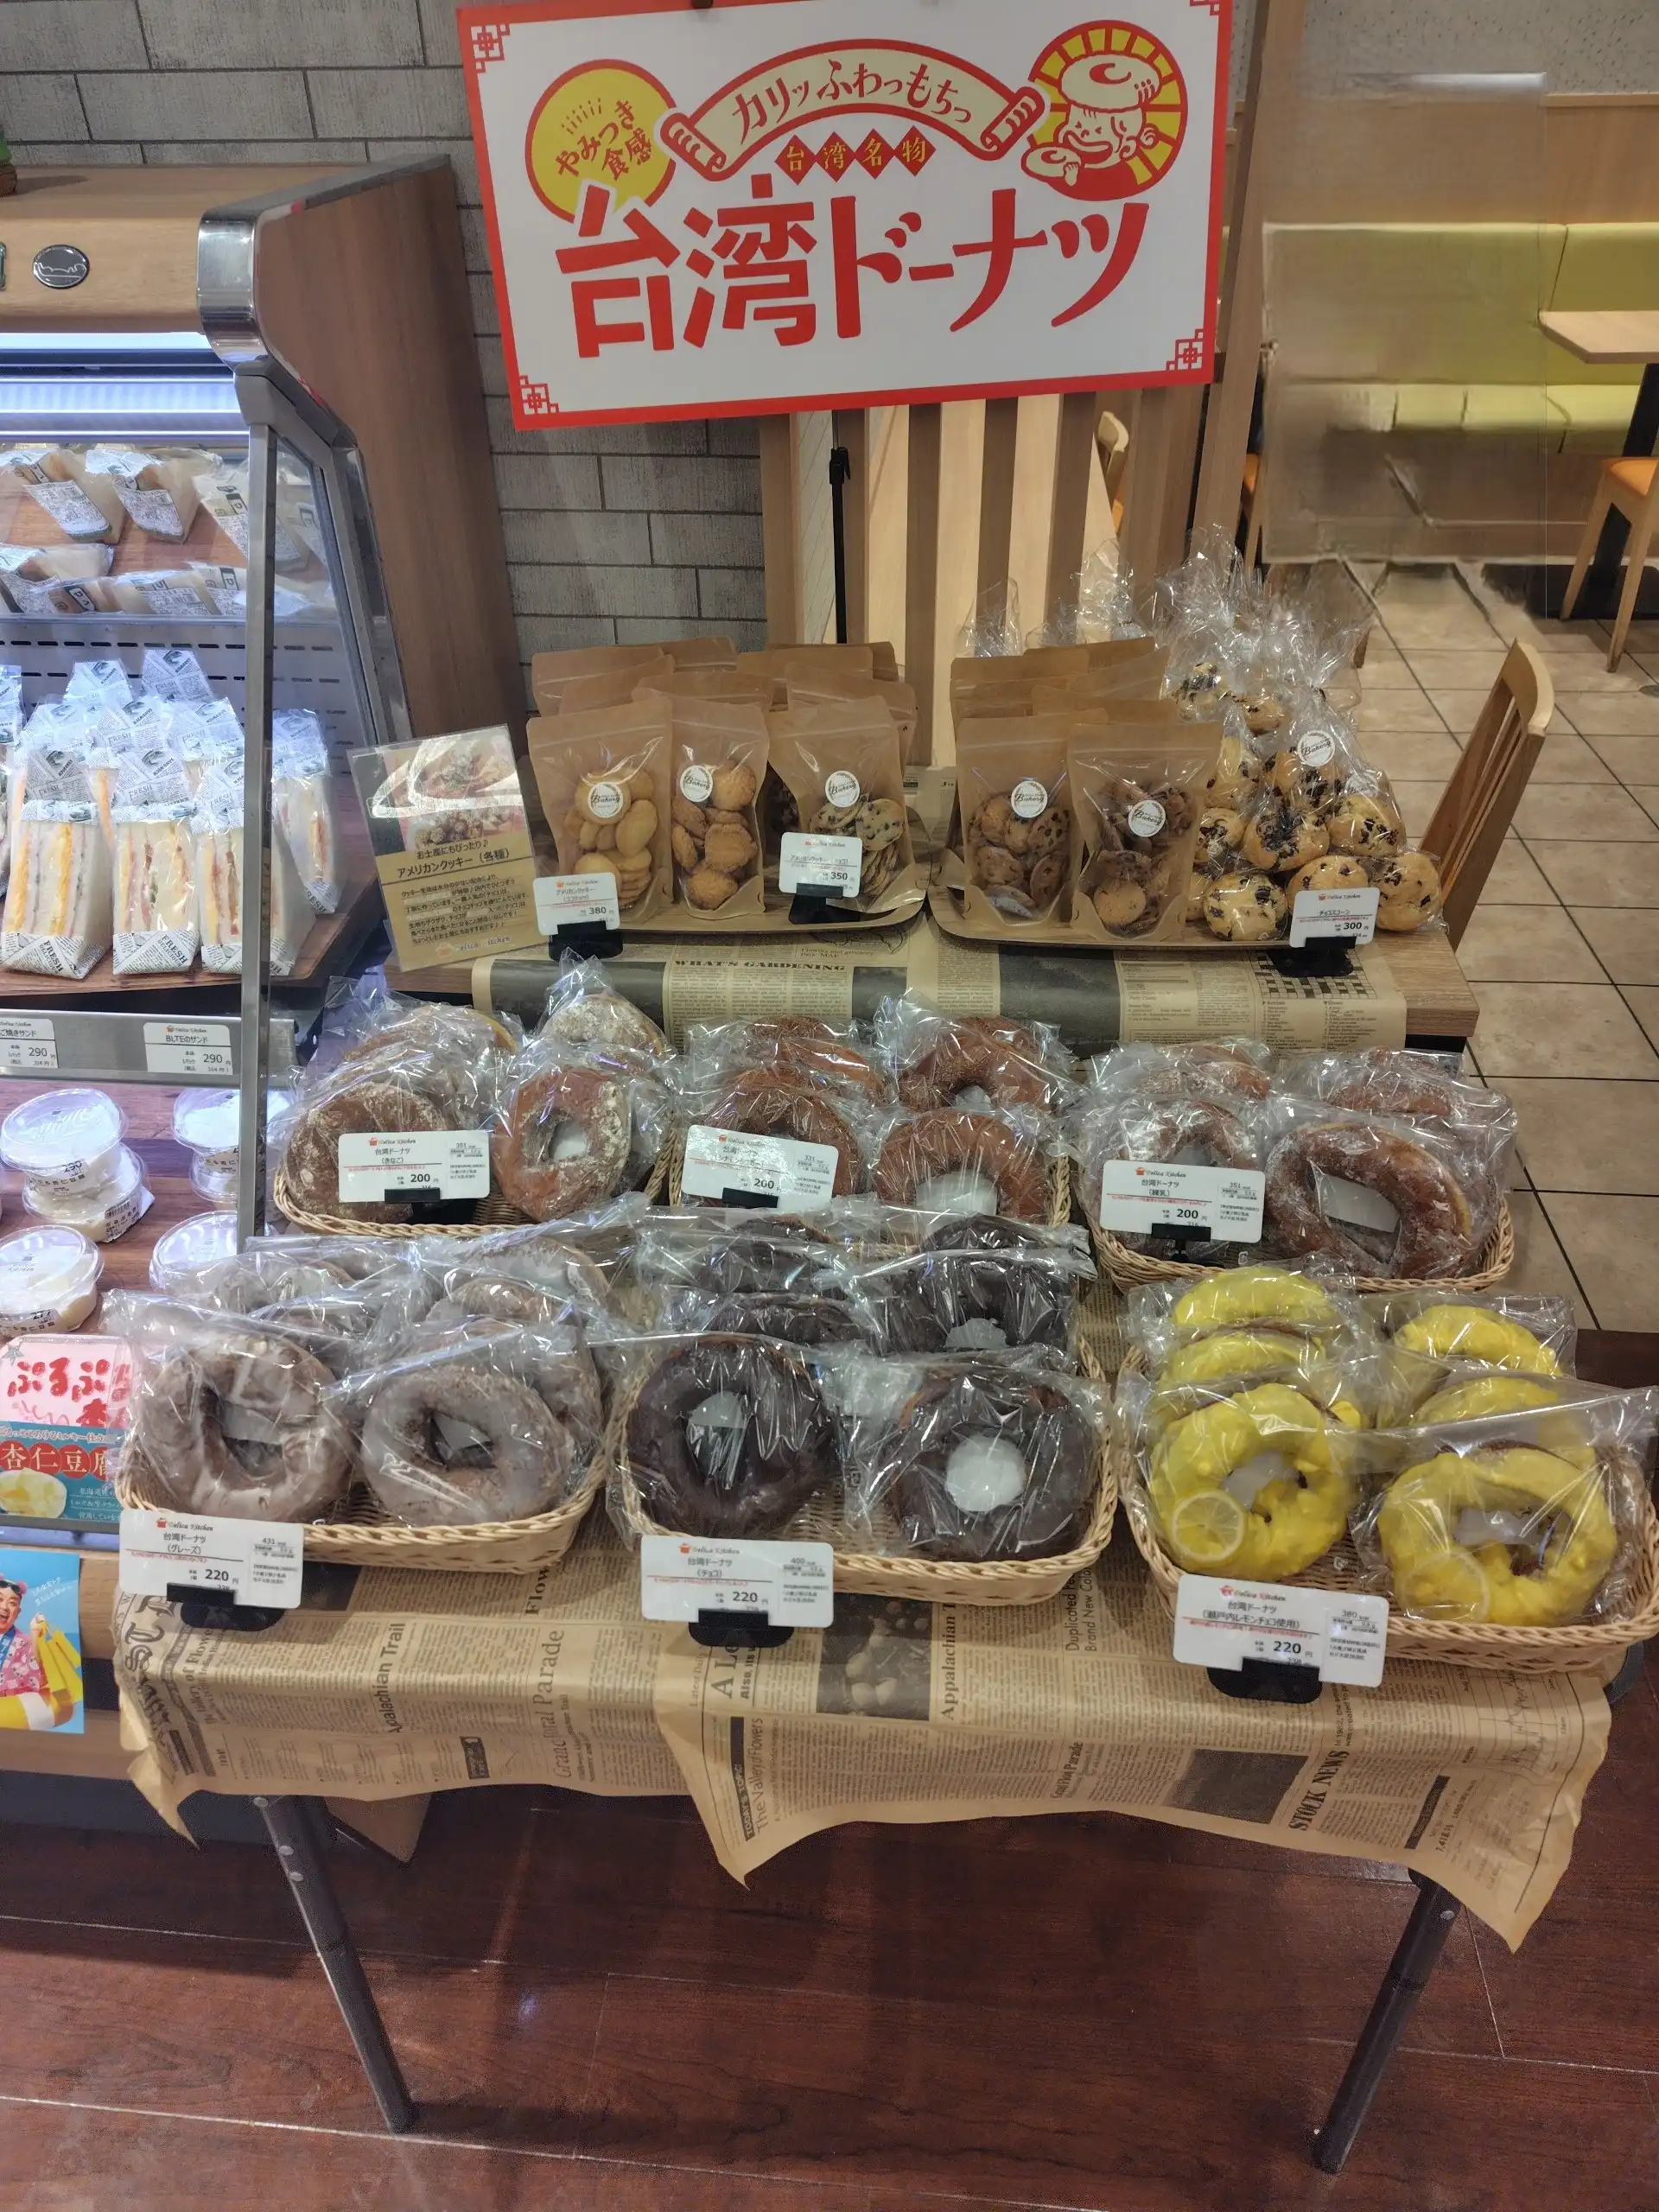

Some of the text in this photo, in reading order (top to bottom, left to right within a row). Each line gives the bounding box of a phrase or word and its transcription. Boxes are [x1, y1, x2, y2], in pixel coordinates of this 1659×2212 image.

[732, 59, 971, 145] カリッふわっもちっ
[555, 97, 636, 177] やみつき
[601, 127, 652, 181] 食感
[785, 137, 926, 175] 台湾名物
[555, 173, 1150, 359] 台湾ドーナツ
[1300, 740, 1332, 756] Bakery
[828, 779, 857, 795] Bakery
[591, 793, 621, 804] Bakery
[1014, 792, 1046, 804] Bakery
[830, 871, 849, 880] 350
[588, 906, 607, 915] 380
[1343, 921, 1363, 931] 300
[43, 939, 64, 972] FRESH
[162, 934, 188, 964] FRESH
[29, 1047, 48, 1057] 290
[203, 1054, 223, 1064] 290
[375, 1147, 411, 1156] 台湾ドーナツ
[410, 1173, 430, 1183] 200
[753, 1177, 775, 1190] 200
[1141, 1179, 1180, 1188] 台湾ドーナツ
[1176, 1208, 1199, 1219] 200
[163, 1533, 207, 1543] 台湾ドーナツ
[167, 1545, 201, 1555] (グレーズ)
[688, 1558, 733, 1567] 台湾ドーナツ
[205, 1568, 229, 1581] 220
[732, 1591, 758, 1603] 220
[1083, 1595, 1097, 1618] New
[1228, 1601, 1277, 1614] 台湾ドーナツ
[1341, 1609, 1357, 1619] 380
[1064, 1592, 1081, 1651] Duplicated
[1082, 1620, 1098, 1652] Brand
[1273, 1640, 1301, 1655] 220
[532, 1630, 565, 1707] Parade
[940, 1615, 961, 1721] Appalachian
[372, 1623, 406, 1734] Apalachian Trail
[710, 1676, 734, 1700] A
[1287, 1750, 1351, 1832] STOCK NEWS
[736, 1795, 754, 1837] TODAY'S
[753, 1800, 769, 1834] The
